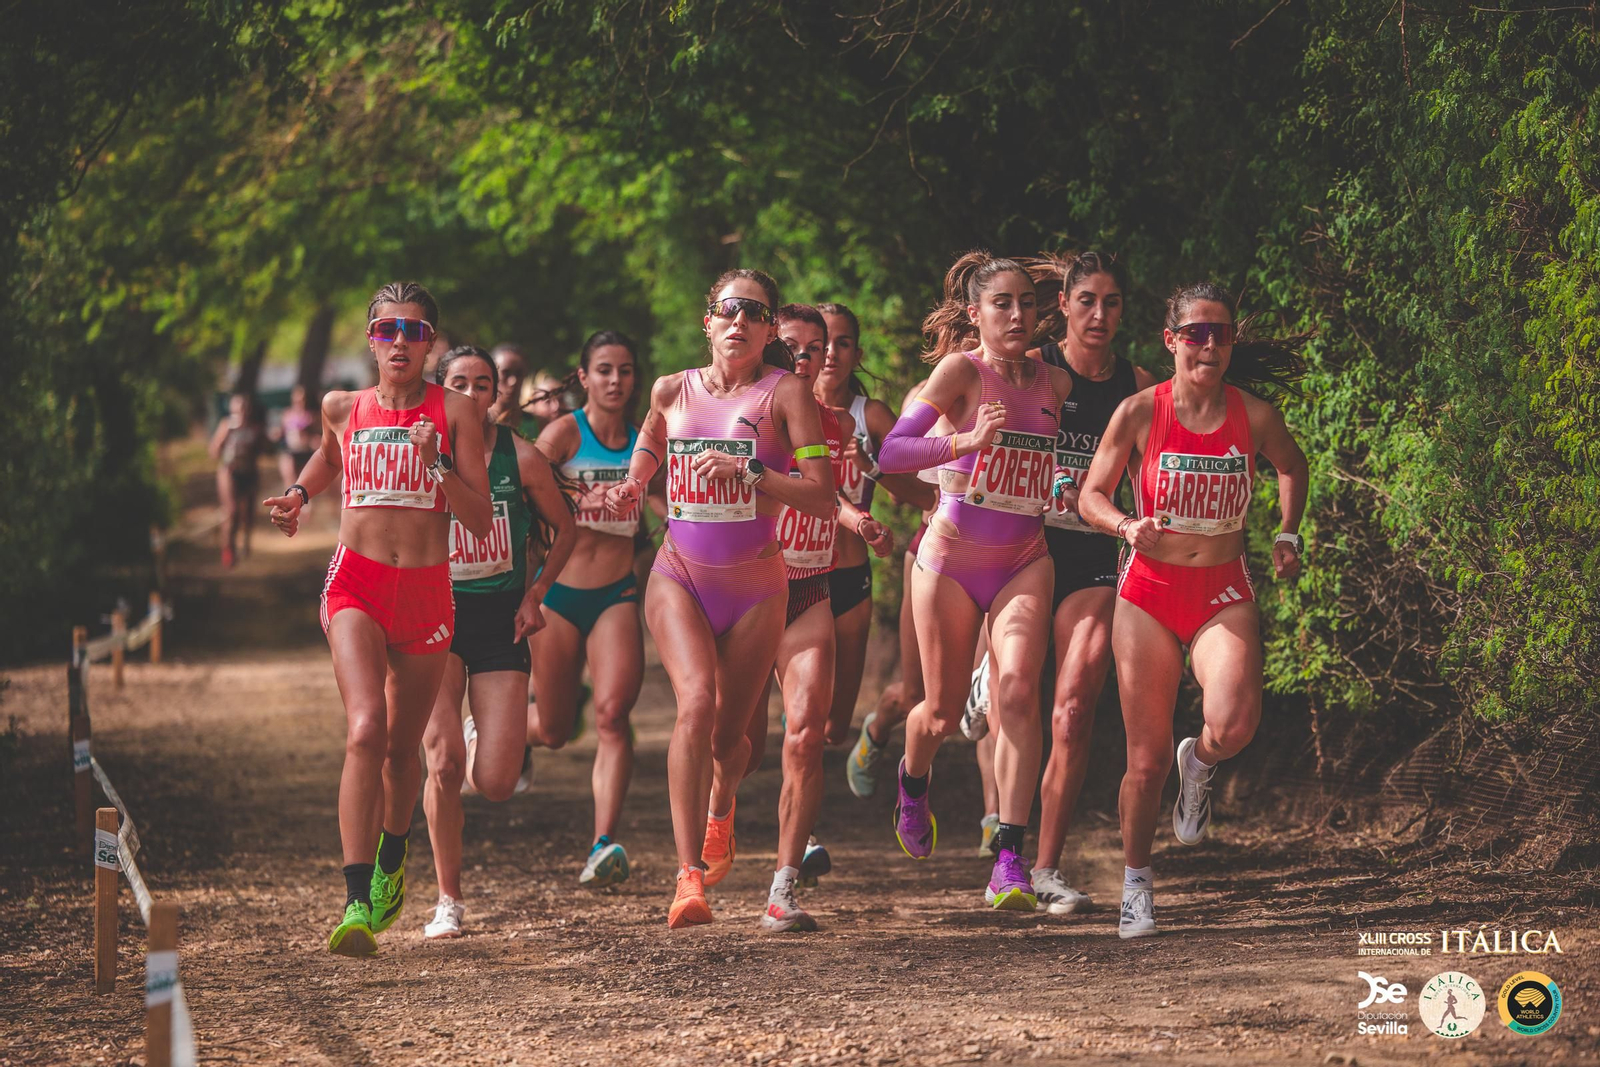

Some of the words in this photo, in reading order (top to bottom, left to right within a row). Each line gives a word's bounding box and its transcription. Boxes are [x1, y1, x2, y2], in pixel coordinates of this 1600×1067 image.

[374, 430, 411, 441] ITÁLIC
[1007, 435, 1041, 448] ITÁLICA
[1062, 455, 1092, 467] ITÁLIC
[1186, 457, 1230, 471] ITÁLICA
[971, 446, 1053, 501] FORERO
[1156, 470, 1247, 520] BARREIRO
[781, 507, 834, 552] OBLES
